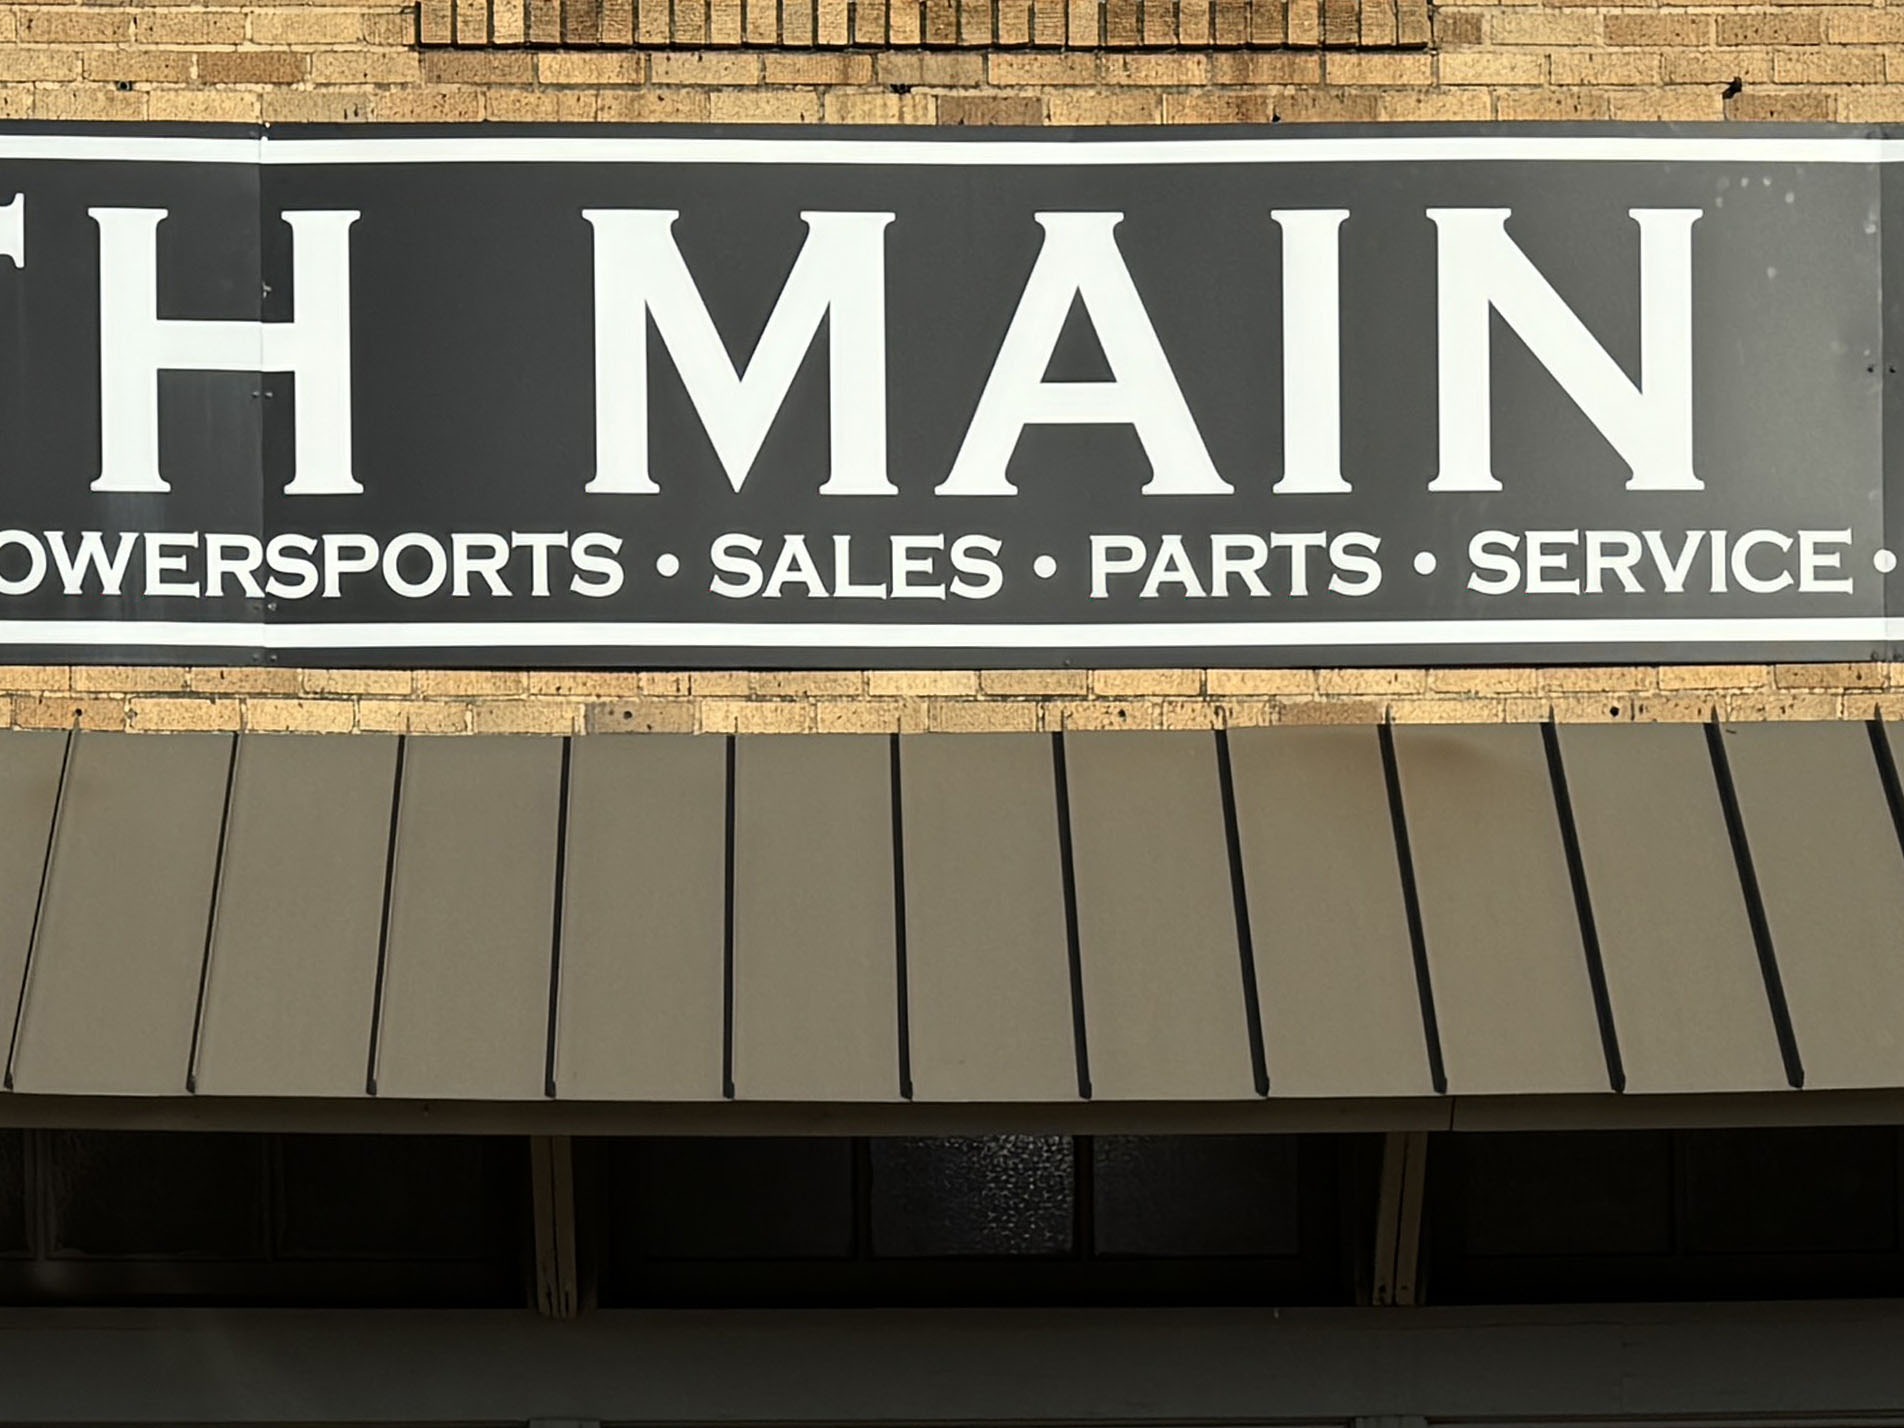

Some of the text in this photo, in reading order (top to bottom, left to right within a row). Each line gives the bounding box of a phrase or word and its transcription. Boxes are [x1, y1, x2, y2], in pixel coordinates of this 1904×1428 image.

[582, 208, 1705, 495] MAIN
[710, 534, 1002, 599] SALES
[1090, 531, 1381, 597] PARTS
[1468, 528, 1853, 595] SERVICE
